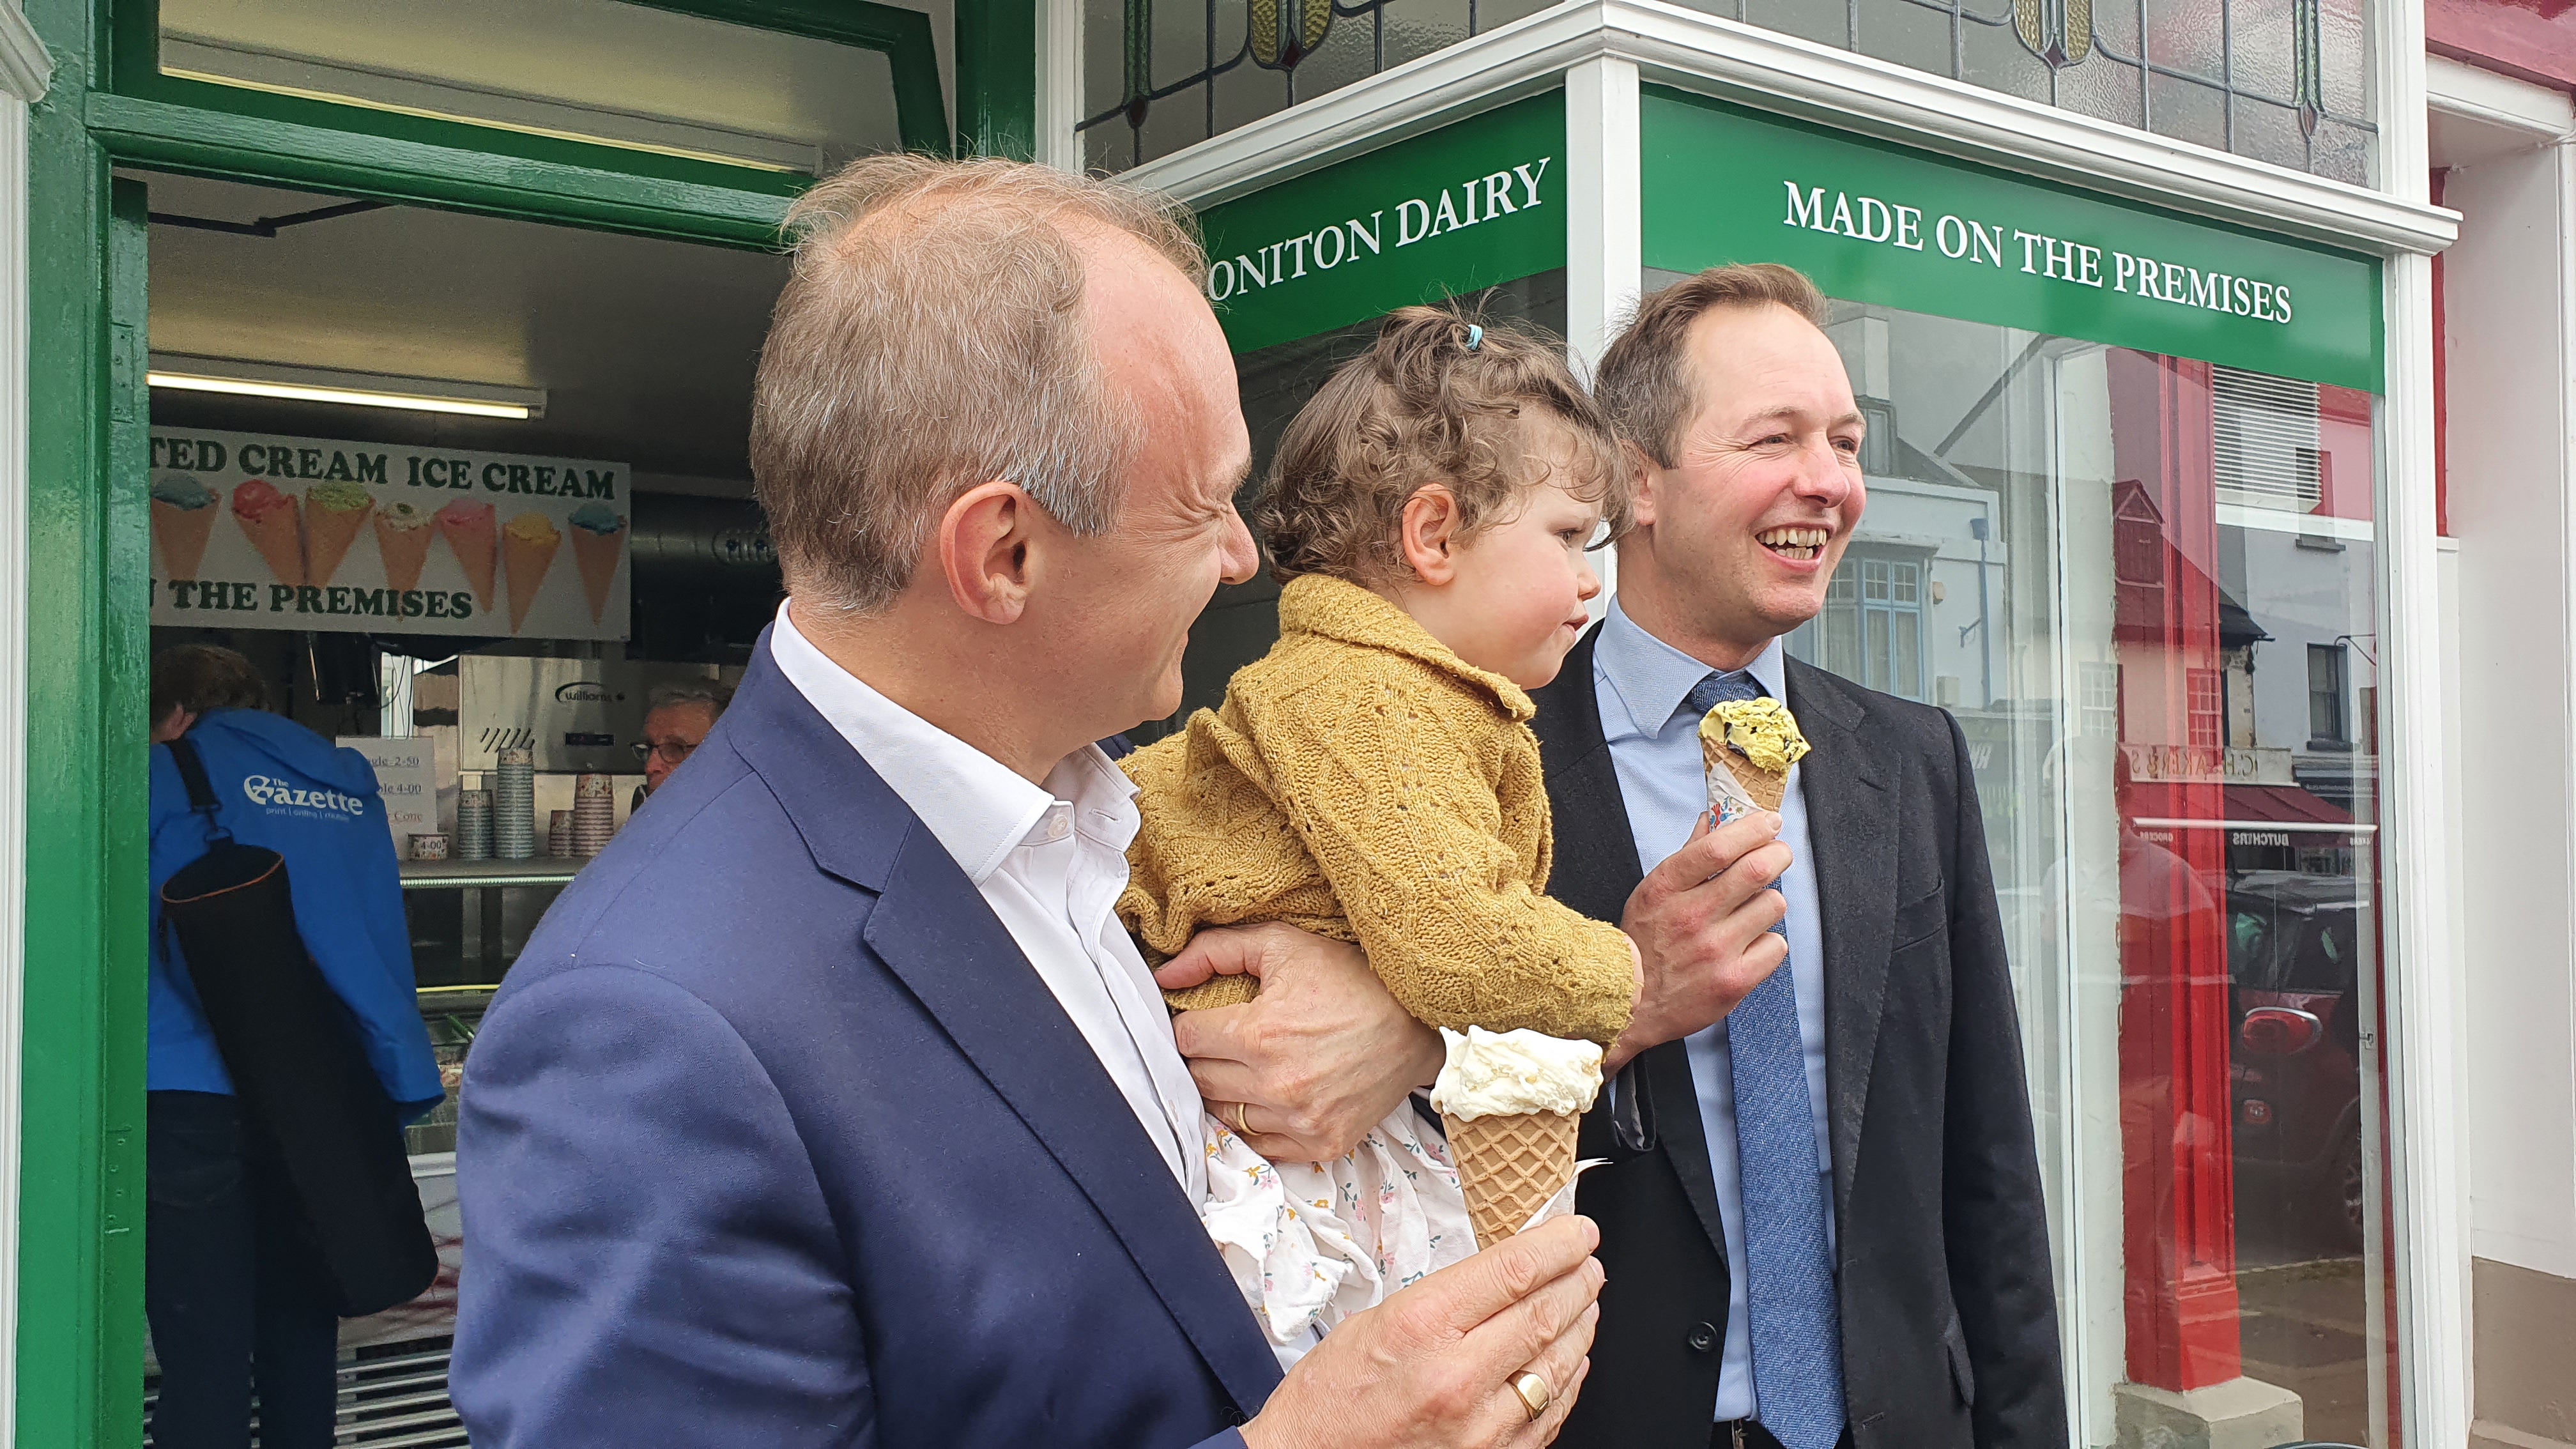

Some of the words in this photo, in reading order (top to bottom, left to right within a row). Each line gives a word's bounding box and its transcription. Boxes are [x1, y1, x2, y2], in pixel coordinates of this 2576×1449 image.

[1208, 210, 1383, 302] ONITON
[1395, 157, 1551, 247] DAIRY
[1782, 180, 1924, 251] MADE
[1936, 214, 2004, 268] ON
[2013, 228, 2103, 289] THE
[2112, 250, 2292, 324] PREMISES
[238, 443, 387, 484] CREAM
[408, 456, 471, 490] ICE
[481, 461, 615, 500] CREAM
[169, 579, 257, 611] THE
[269, 583, 473, 618] PREMISES
[244, 775, 364, 815] Gazette
[272, 778, 289, 786] The
